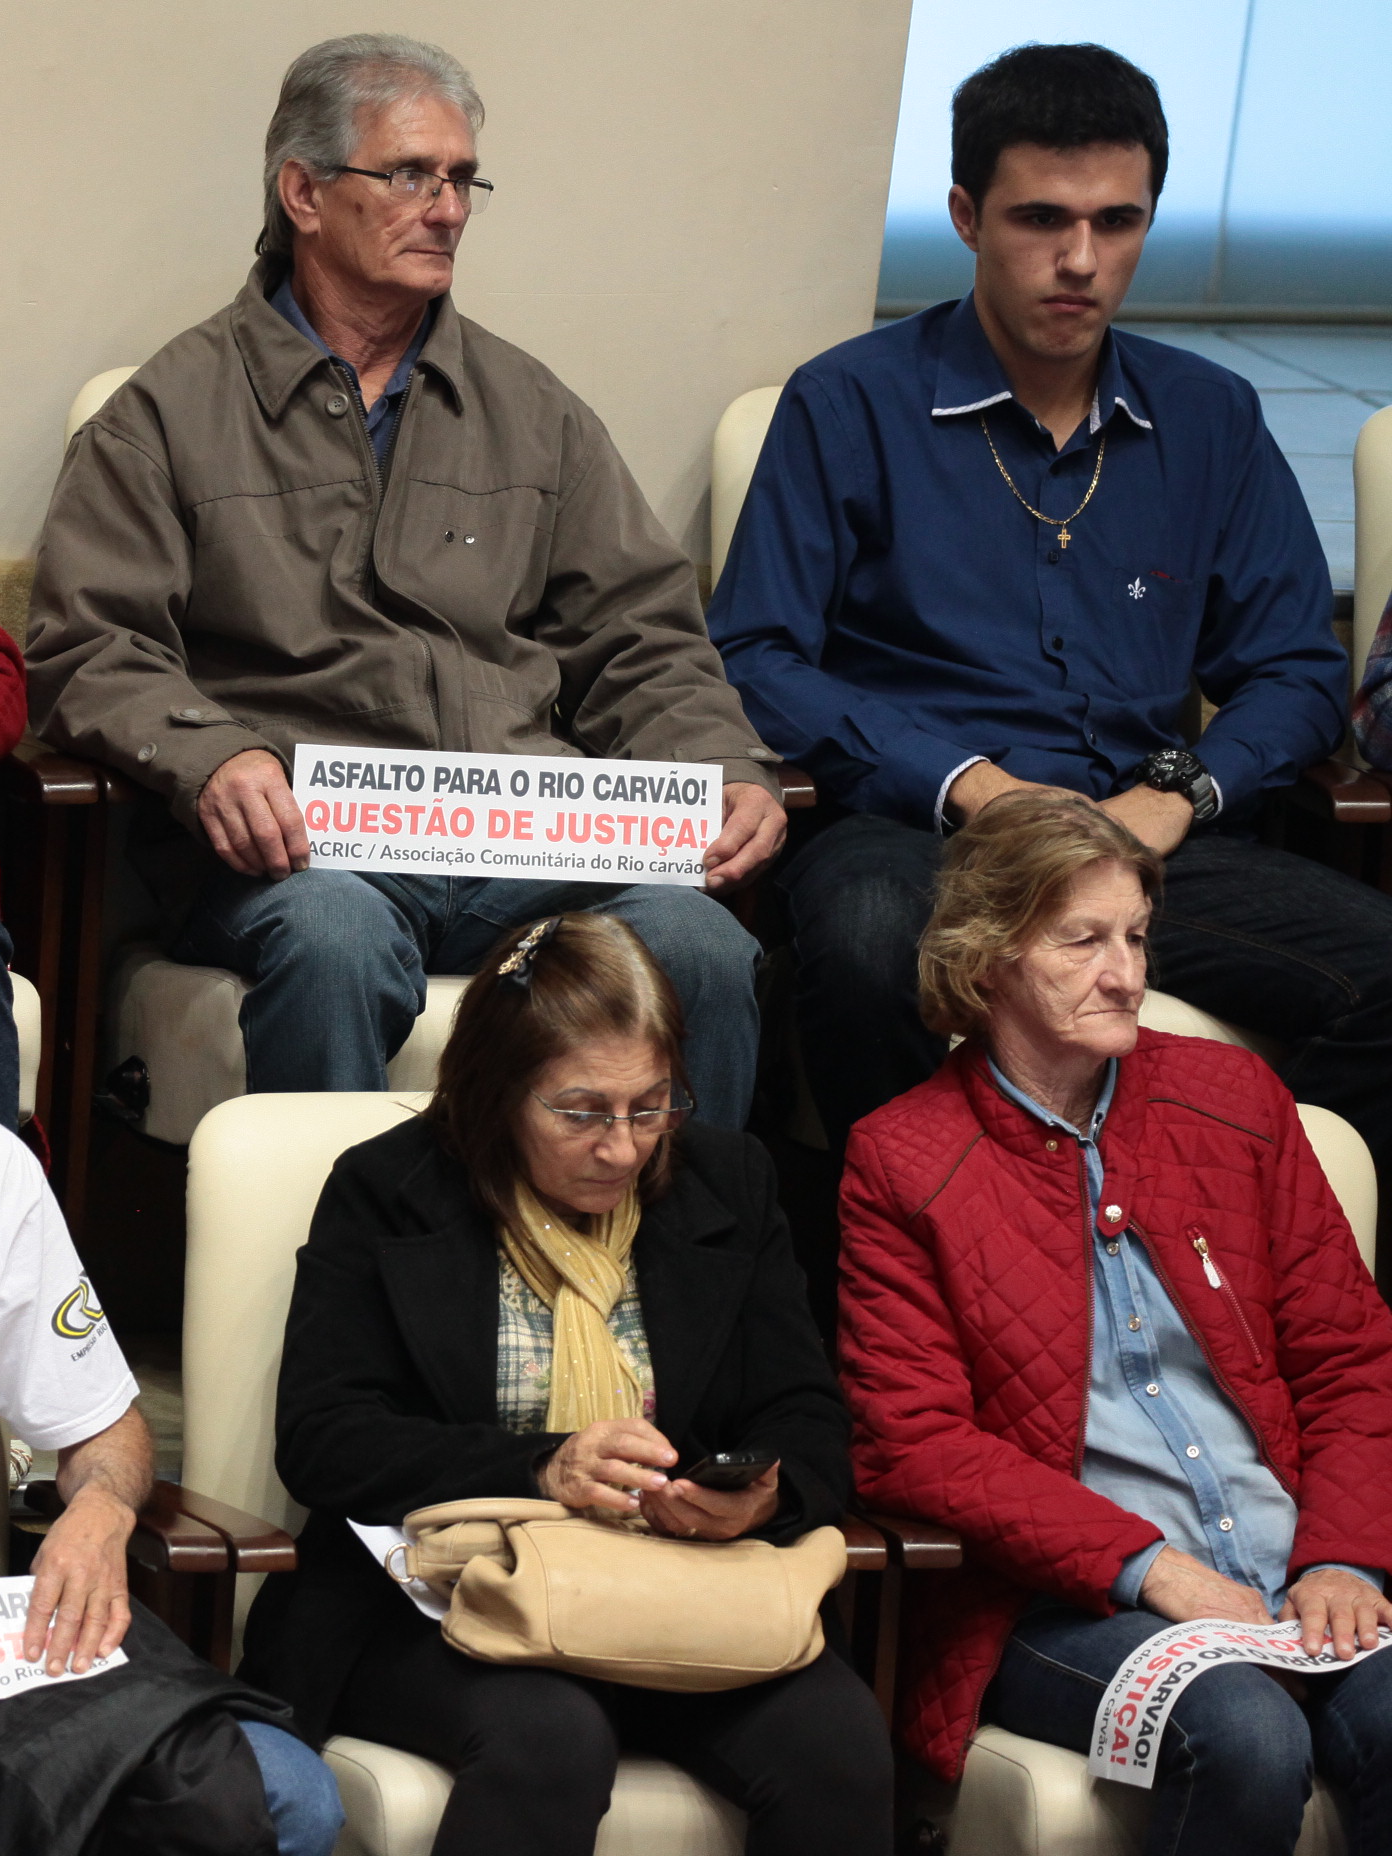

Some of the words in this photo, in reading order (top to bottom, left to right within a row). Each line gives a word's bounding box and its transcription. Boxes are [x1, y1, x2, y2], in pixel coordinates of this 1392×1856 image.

[309, 760, 425, 793] ASFALTO
[433, 766, 502, 796] PARA
[510, 769, 530, 798] O
[538, 771, 585, 800] RIO
[593, 770, 708, 806] CARVÃO!
[305, 798, 475, 840] QUESTÃO
[487, 809, 534, 841] DE
[545, 811, 708, 857] JUSTIÇA!
[309, 840, 363, 859] ACRIC
[367, 843, 377, 860] /
[380, 844, 475, 866] Associação
[480, 849, 585, 870] Comunitária
[590, 854, 612, 870] do
[617, 855, 644, 872] Rio
[649, 858, 704, 875] carvão
[1212, 1631, 1266, 1648] DE
[14, 1665, 45, 1682] Rio
[1114, 1669, 1135, 1694] Rio
[1110, 1634, 1209, 1766] JUSTIÇA!
[1133, 1661, 1198, 1769] CARVÃO!
[1096, 1698, 1115, 1757] carvão
